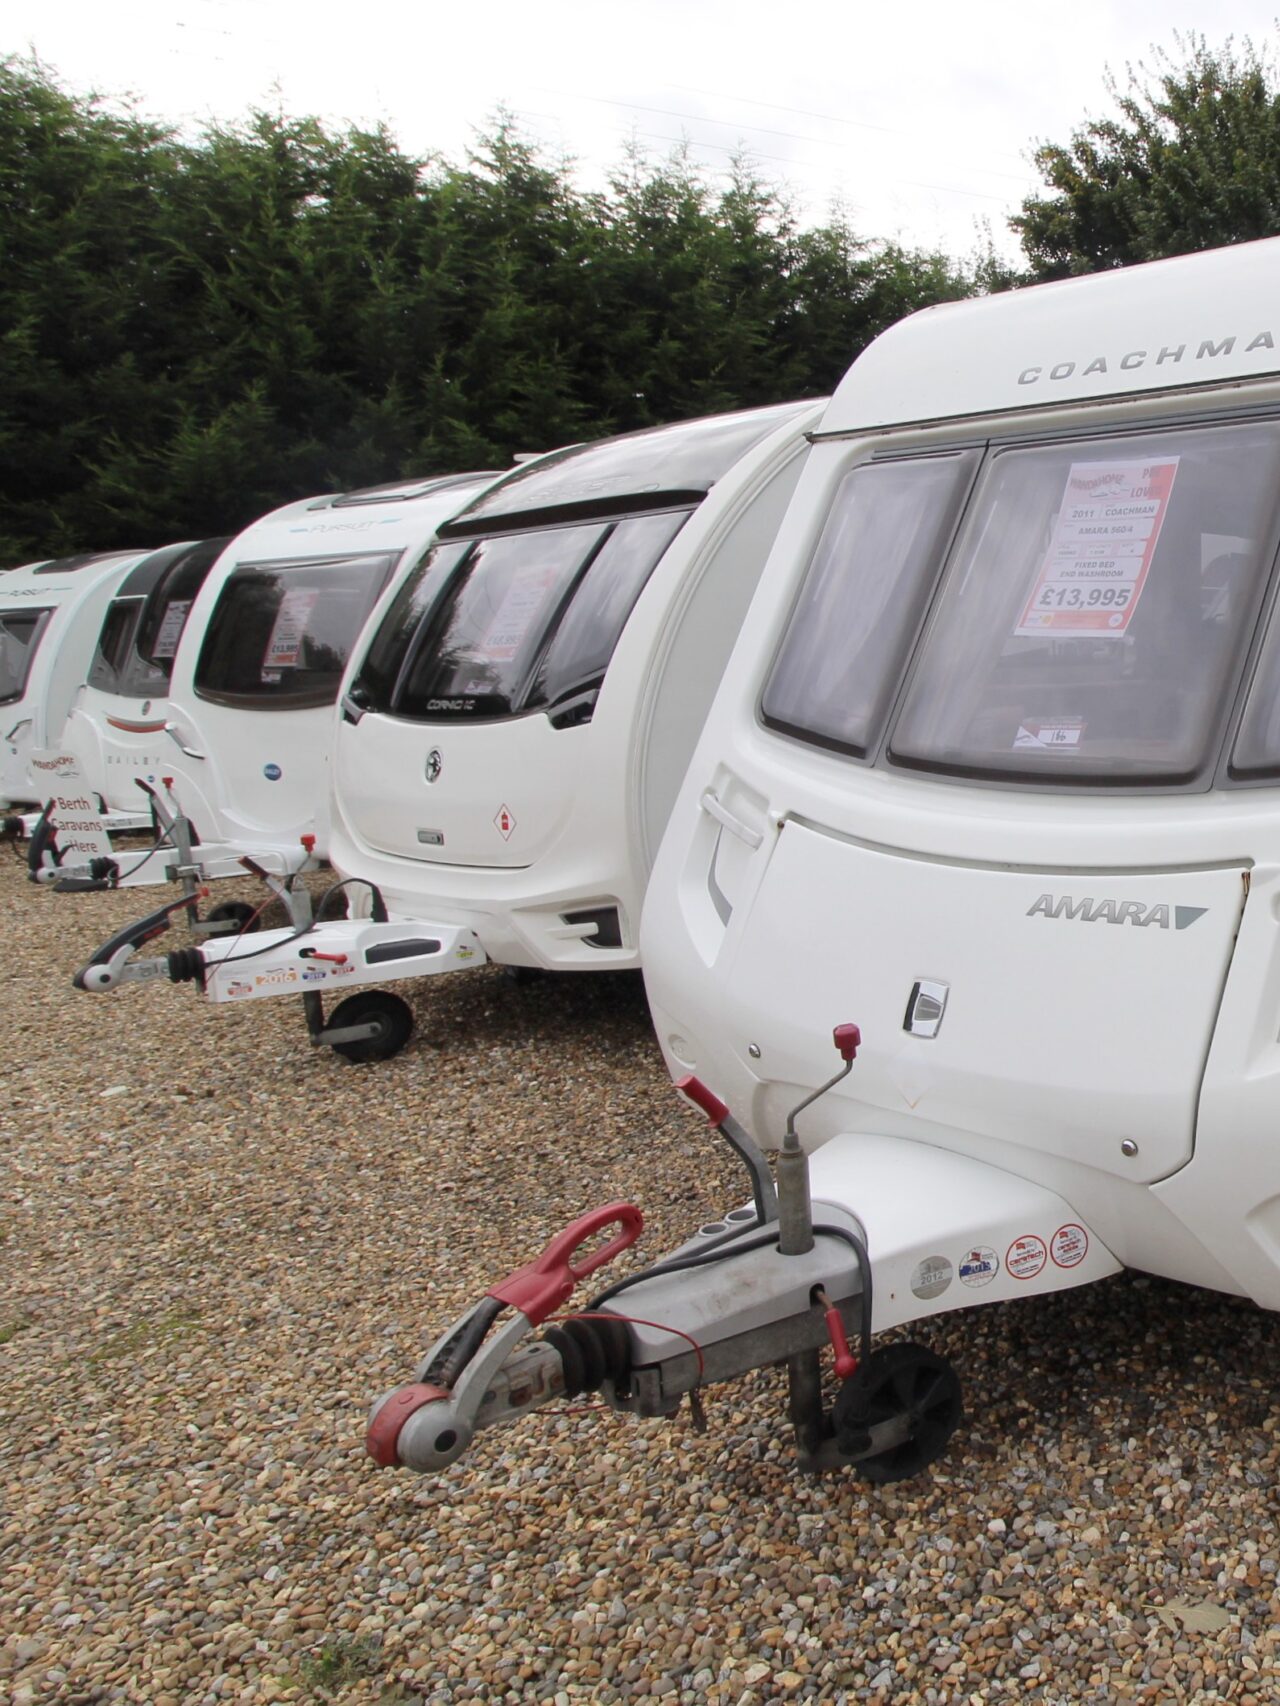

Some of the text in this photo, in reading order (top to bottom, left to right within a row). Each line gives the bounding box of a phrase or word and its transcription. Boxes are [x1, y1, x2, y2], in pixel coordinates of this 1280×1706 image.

[1072, 506, 1155, 518] 2011 COACHMAN
[1079, 526, 1108, 535] AMARA
[1040, 588, 1131, 609] £13,995
[57, 797, 91, 810] Berth
[69, 839, 98, 853] Here
[1025, 894, 1170, 930] AMARA
[261, 973, 293, 985] 2016
[921, 1271, 944, 1285] 2012
